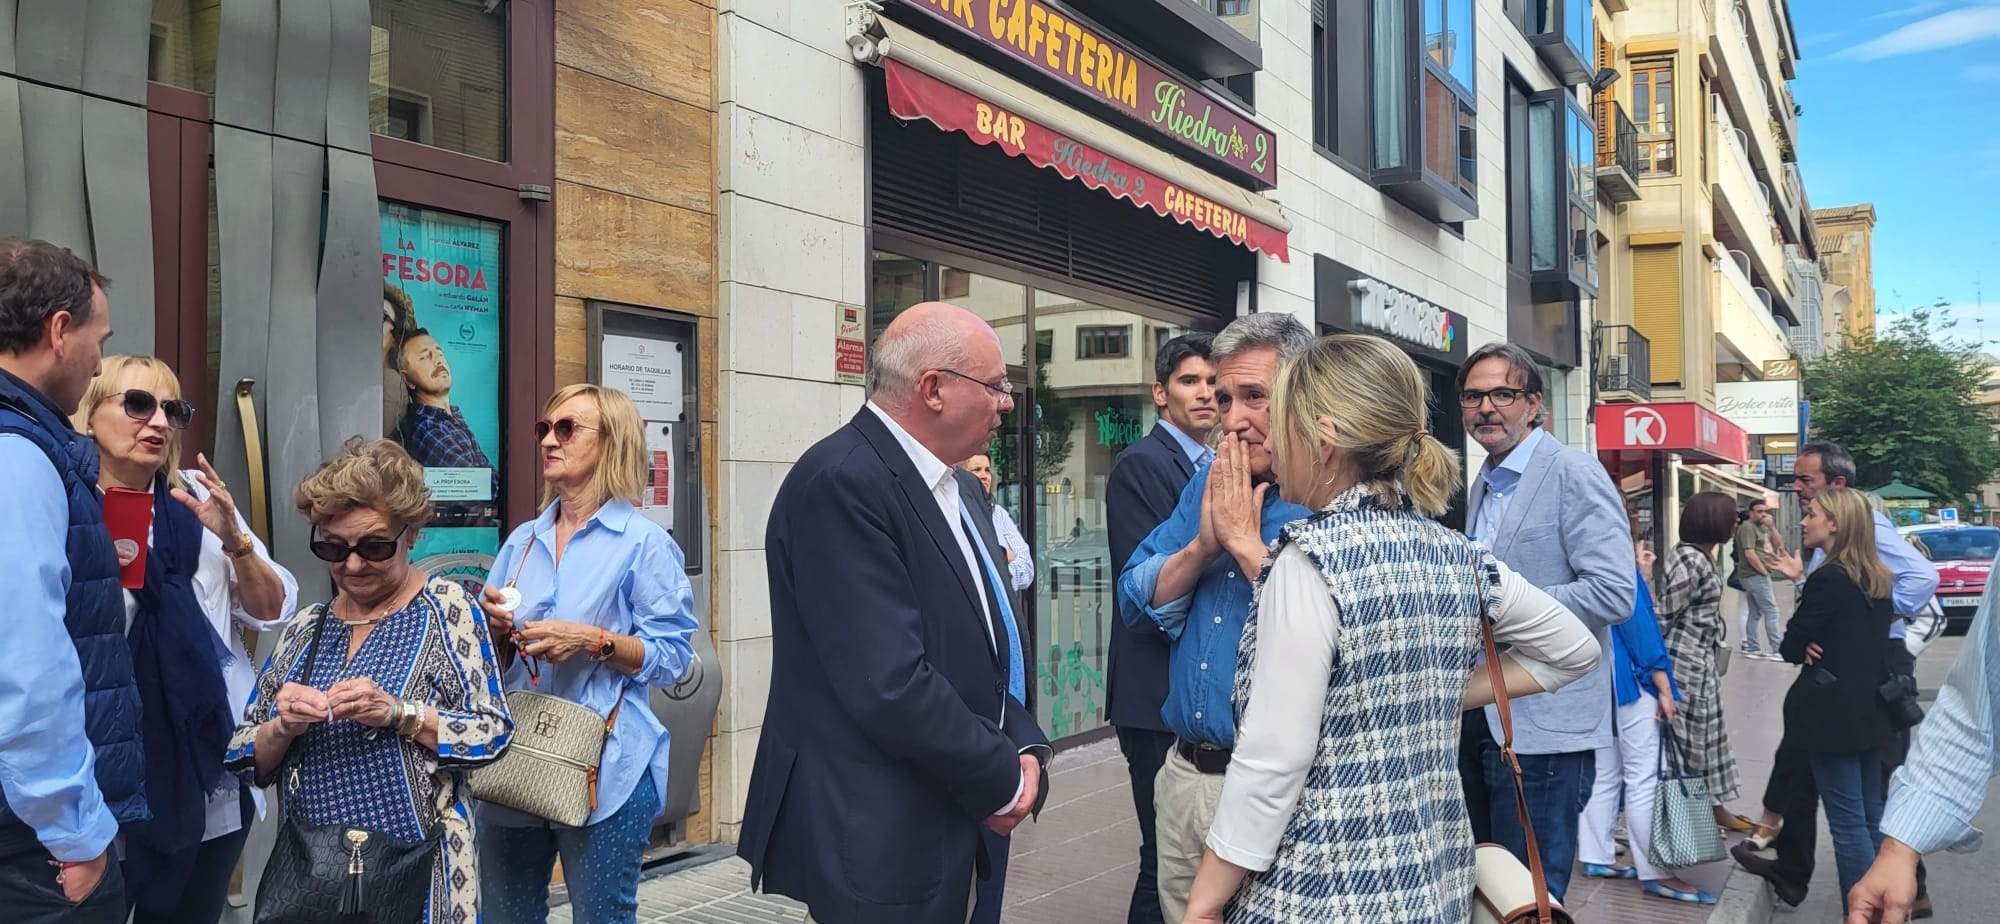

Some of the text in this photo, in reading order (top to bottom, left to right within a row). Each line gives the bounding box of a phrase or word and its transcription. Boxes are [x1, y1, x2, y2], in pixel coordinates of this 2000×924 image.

[988, 0, 1138, 109] CAFETERIA
[1151, 81, 1268, 173] Hiedra 2
[976, 103, 1248, 242] BAR Hiedra 2 CAFETERIA
[398, 237, 415, 251] LA
[838, 340, 864, 353] Alarma
[609, 363, 672, 376] HORARIO DE TAQUILLAS
[1717, 395, 1793, 414] Dolce vita
[1623, 412, 1661, 447] K
[1943, 511, 1953, 520] L
